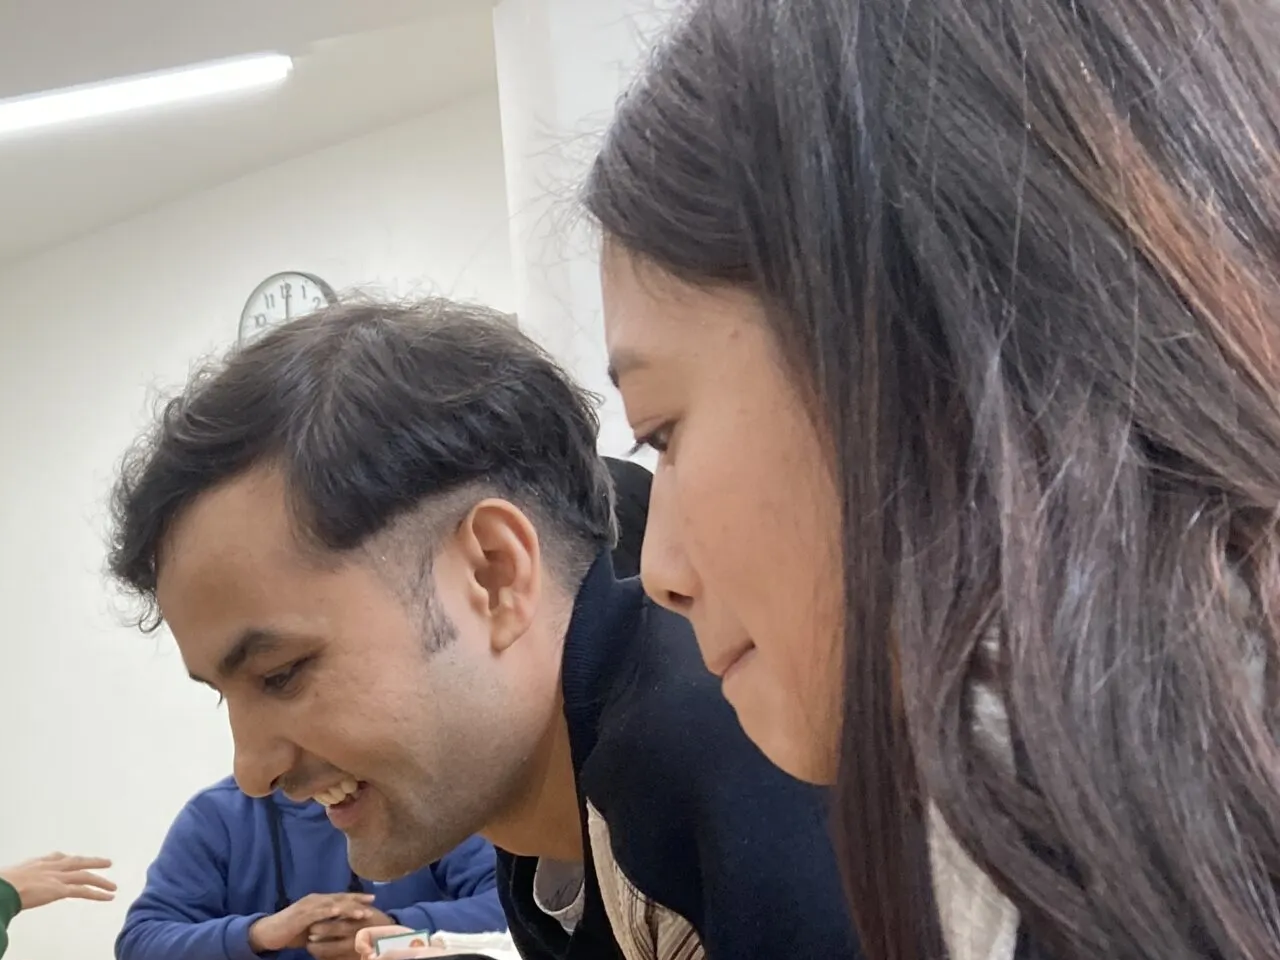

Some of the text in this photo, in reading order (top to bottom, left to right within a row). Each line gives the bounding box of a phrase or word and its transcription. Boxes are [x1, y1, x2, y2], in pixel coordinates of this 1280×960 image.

[301, 284, 308, 300] 1
[262, 292, 276, 309] 11
[254, 313, 268, 329] 10
